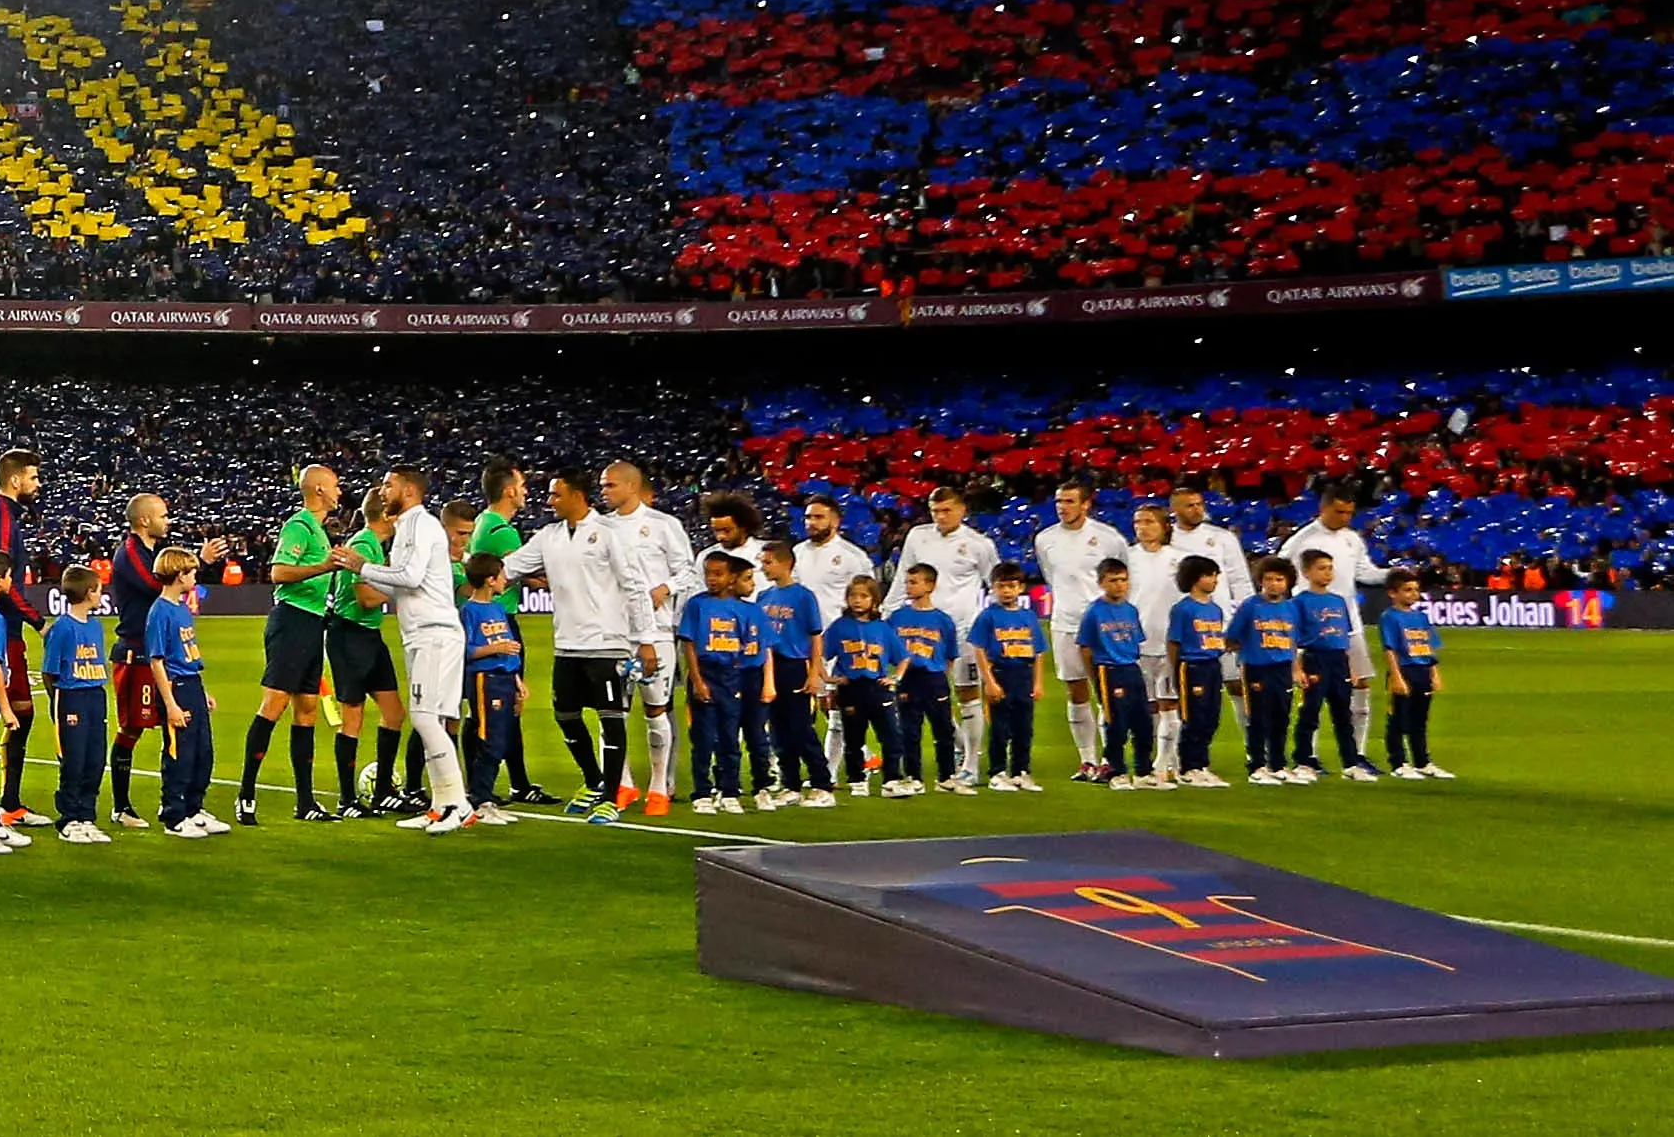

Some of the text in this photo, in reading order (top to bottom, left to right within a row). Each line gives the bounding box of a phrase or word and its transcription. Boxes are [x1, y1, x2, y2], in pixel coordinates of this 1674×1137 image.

[1082, 293, 1205, 314] QATAR AIRWAYS
[1266, 282, 1398, 304] QATAR AIRWAYS
[8, 309, 63, 324] AIRWAYS
[110, 308, 213, 325] QATAR AIRWAYS
[259, 309, 360, 326] QATAR AIRWAYS
[406, 311, 511, 327] QATAR AIRWAYS
[561, 310, 674, 327] QATAR AIRWAYS
[726, 306, 845, 324] QATAR AIRWAYS
[958, 300, 1025, 317] AIRWAYS
[185, 589, 198, 613] 4
[517, 586, 554, 613] Joh
[1483, 594, 1554, 626] Johan
[1565, 597, 1603, 625] 14
[142, 684, 151, 705] 8
[411, 683, 421, 705] 4
[605, 680, 614, 702] 1
